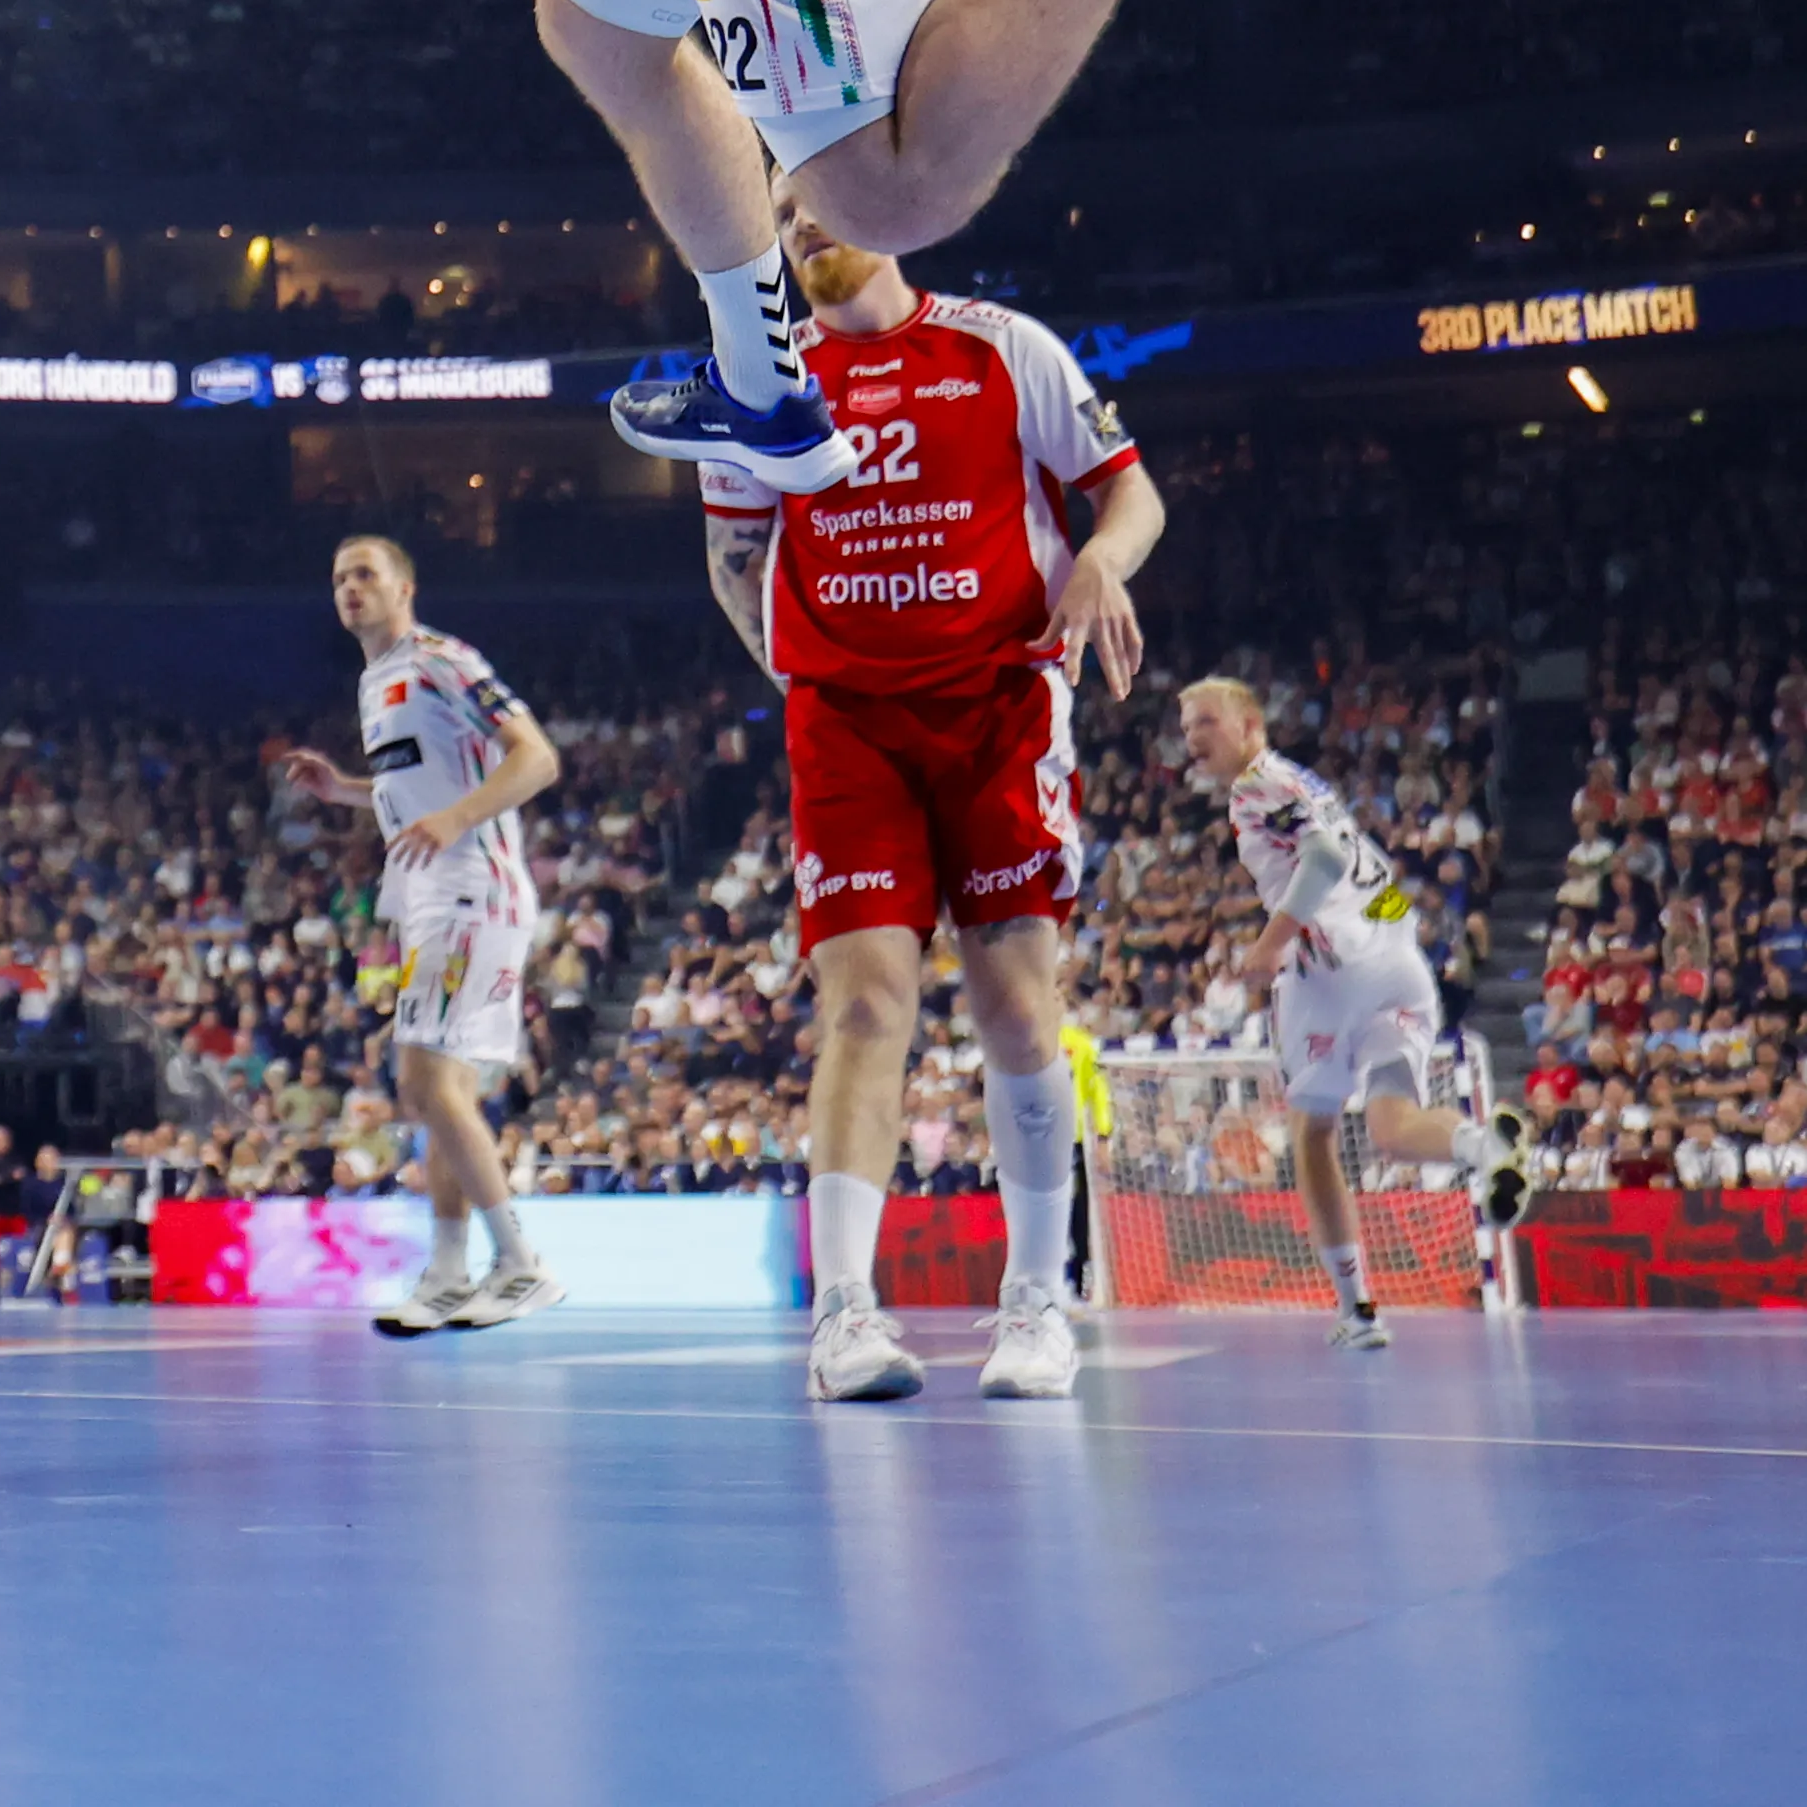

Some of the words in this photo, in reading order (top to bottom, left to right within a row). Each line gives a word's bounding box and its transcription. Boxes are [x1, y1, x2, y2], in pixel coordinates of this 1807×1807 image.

[1418, 303, 1482, 354] 3RD
[1483, 293, 1583, 348] PLACE
[1584, 285, 1698, 341] MATCH
[845, 420, 919, 487] 22
[810, 499, 973, 541] Sparekassen
[841, 531, 945, 556] DANMARK
[817, 562, 979, 612] complea
[850, 869, 896, 891] BYG
